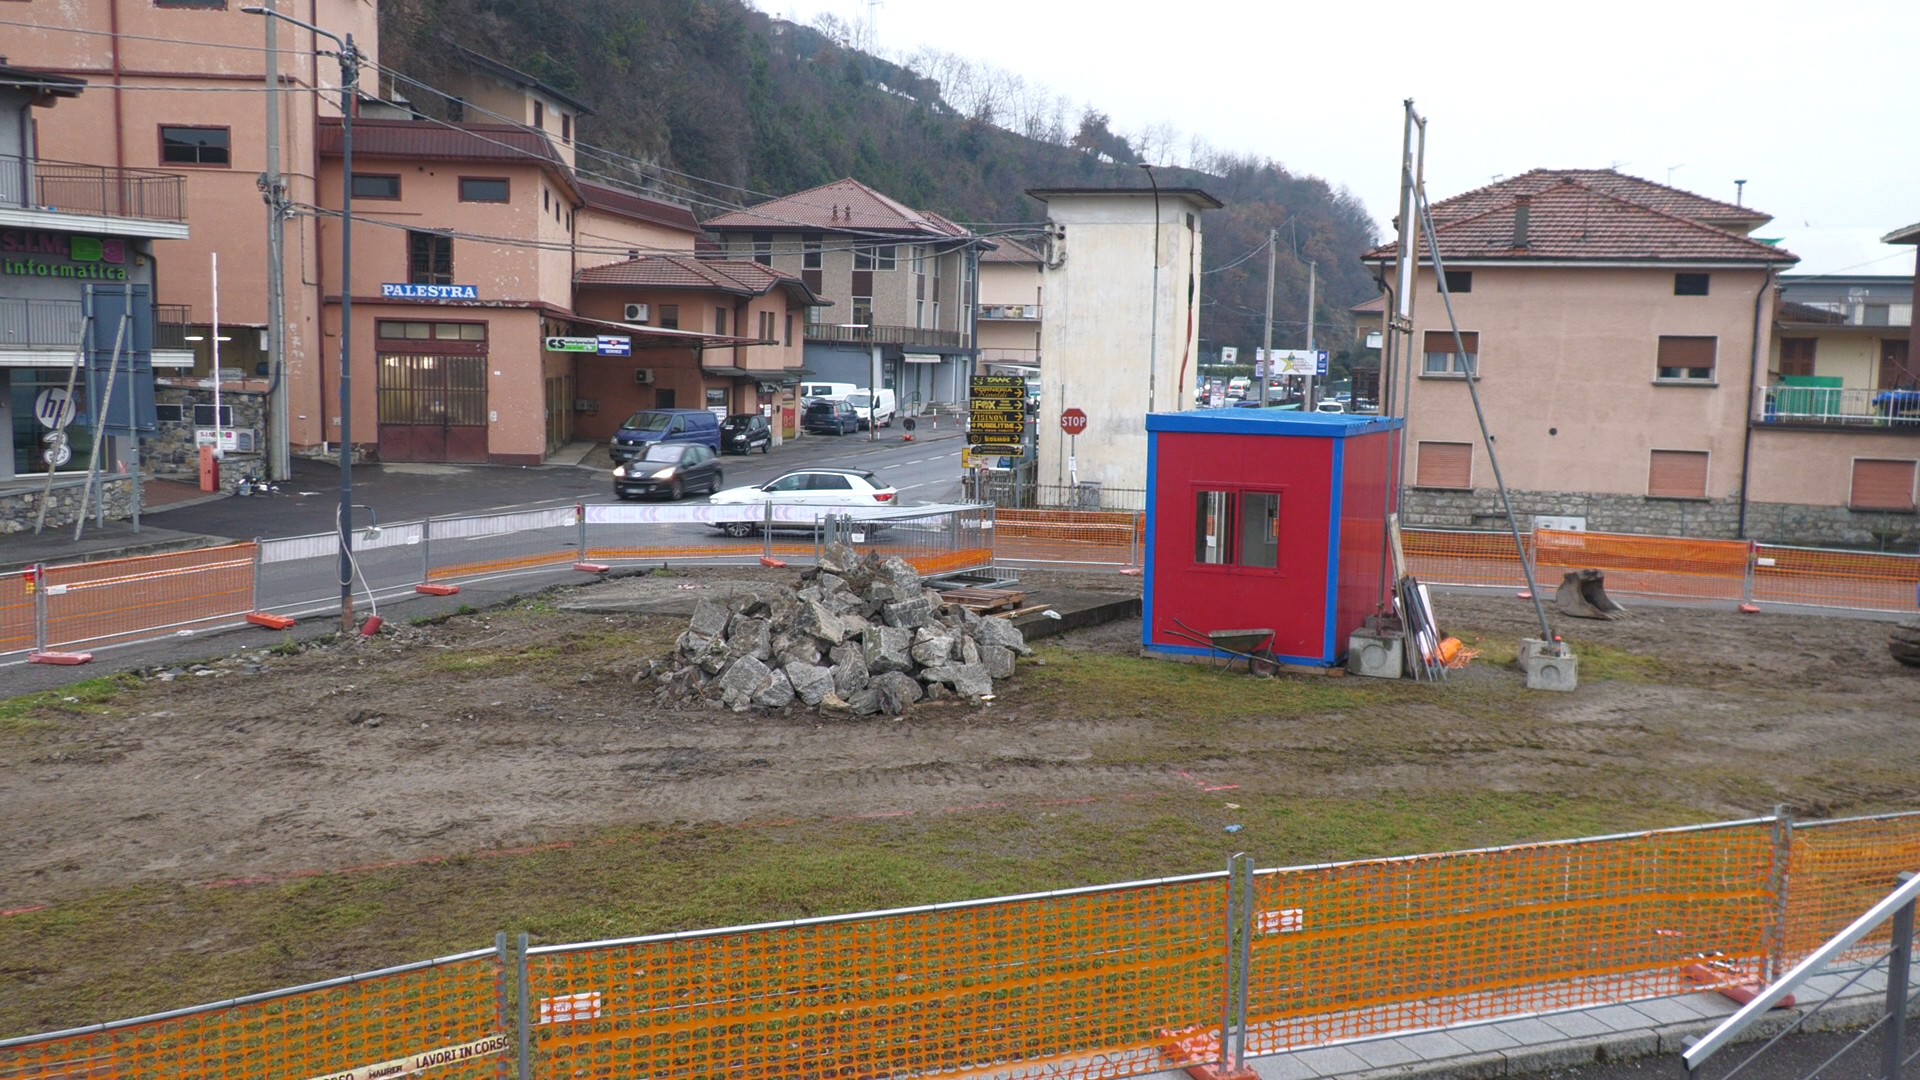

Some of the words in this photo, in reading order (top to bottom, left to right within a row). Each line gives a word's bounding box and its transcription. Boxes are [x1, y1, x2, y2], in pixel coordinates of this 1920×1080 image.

[5, 259, 126, 280] informatica
[382, 285, 476, 298] PALESTRA
[1062, 416, 1086, 427] STOP
[416, 1049, 456, 1068] LAVORI
[460, 1046, 472, 1058] IN
[368, 1065, 403, 1079] MAURER
